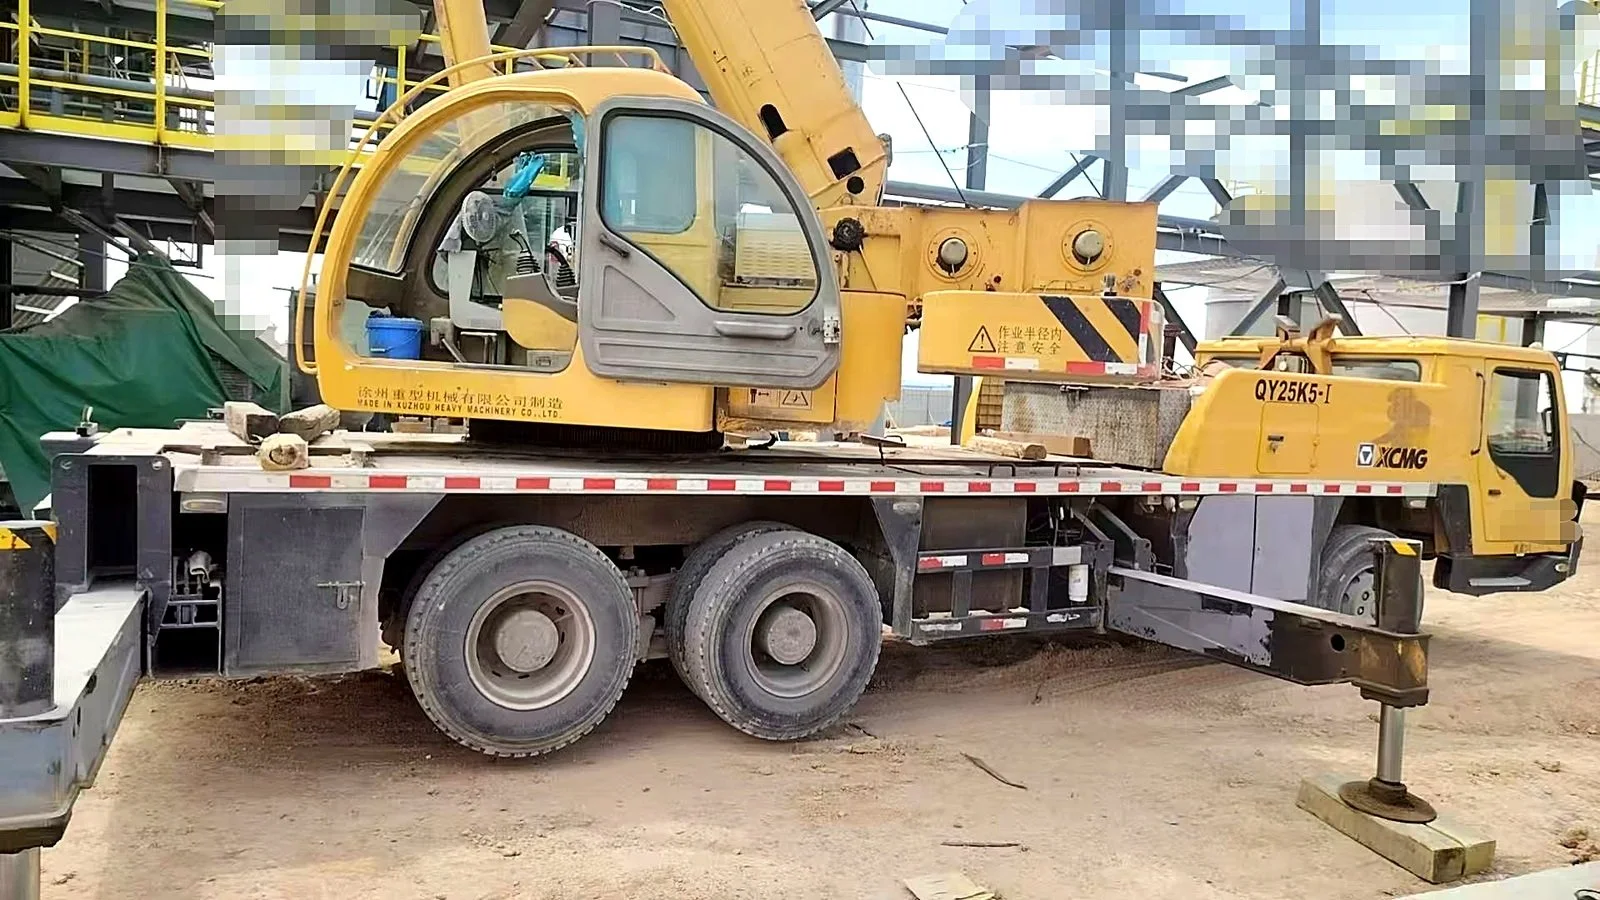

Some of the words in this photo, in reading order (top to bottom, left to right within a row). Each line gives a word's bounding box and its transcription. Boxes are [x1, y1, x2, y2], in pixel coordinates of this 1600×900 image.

[999, 325, 1062, 341] 作业半径内
[998, 341, 1061, 355] 注意安全
[358, 387, 563, 409] 徐州重型机械有限公司制造
[357, 399, 379, 408] MADE
[384, 401, 392, 409] IN
[397, 401, 430, 411] XUZHOU
[435, 403, 462, 412] HEAVY
[467, 405, 516, 416] MACHINERY
[1373, 446, 1428, 470] XCMG
